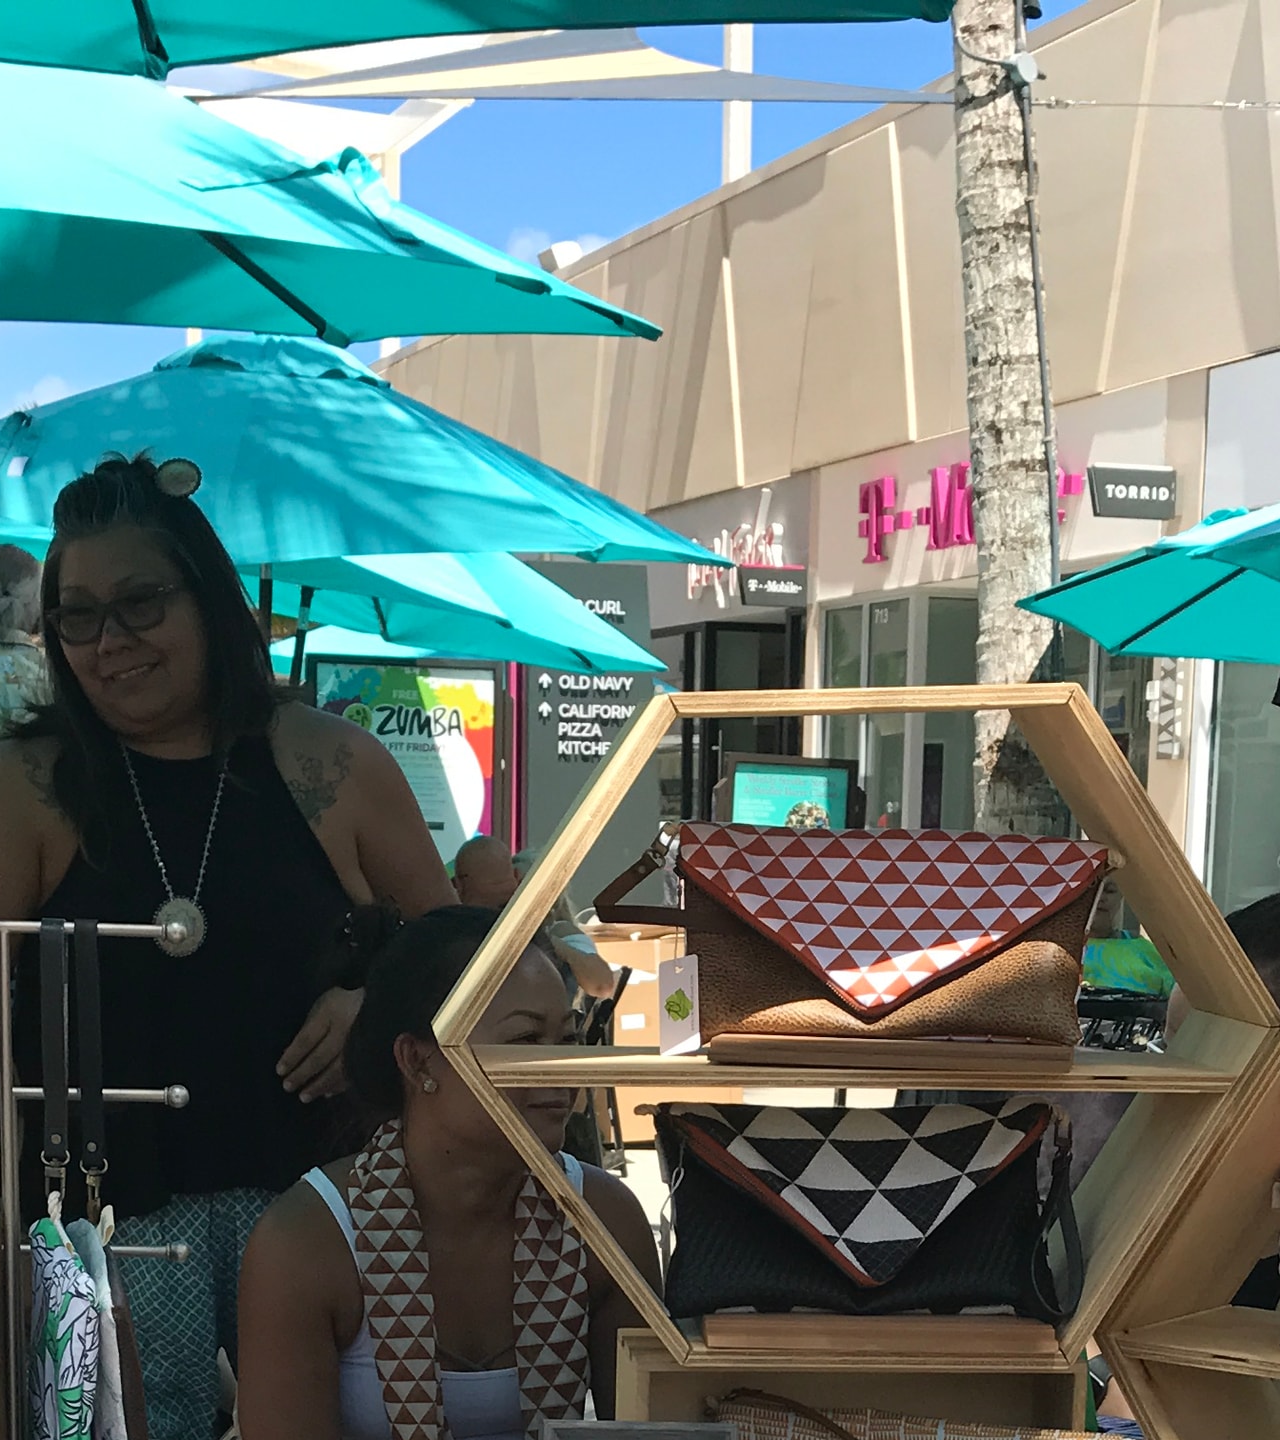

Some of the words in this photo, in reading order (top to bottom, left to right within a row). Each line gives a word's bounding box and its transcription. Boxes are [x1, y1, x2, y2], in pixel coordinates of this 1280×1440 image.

[1105, 483, 1170, 502] TORRID
[585, 599, 626, 616] CURL
[873, 607, 889, 624] 713
[558, 674, 590, 691] OLD
[593, 676, 634, 691] NAVY
[558, 703, 636, 719] CALIFORN
[375, 705, 463, 738] ZUMBA
[558, 722, 602, 737] PIZZA
[558, 739, 612, 756] KITCHE
